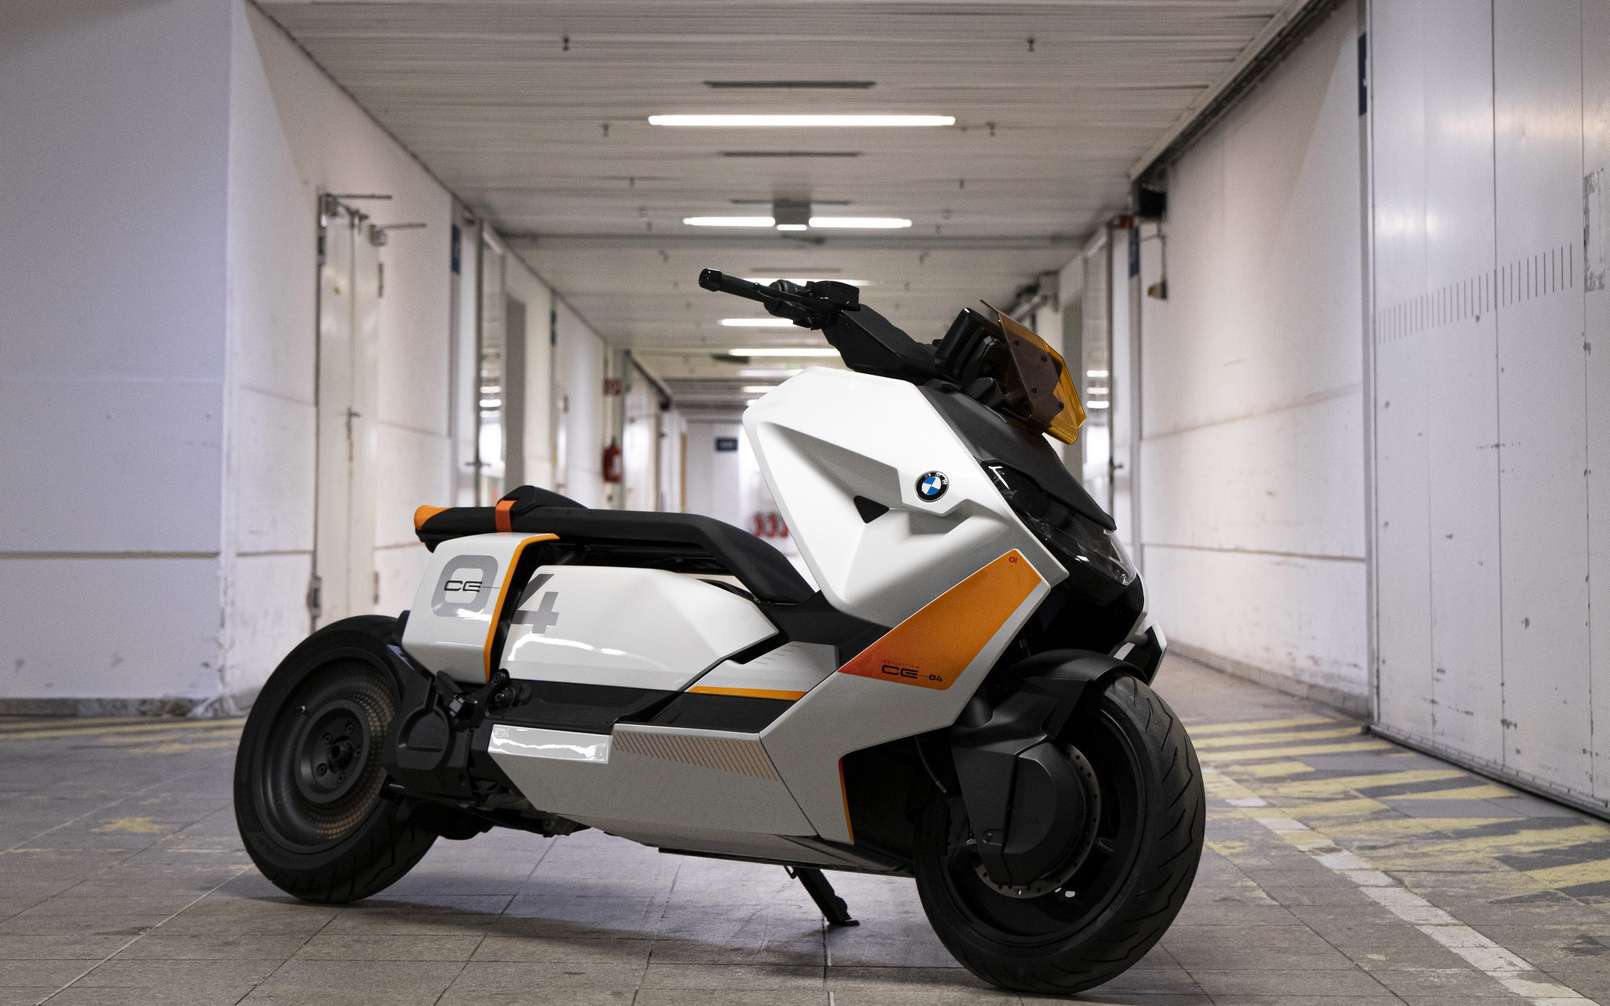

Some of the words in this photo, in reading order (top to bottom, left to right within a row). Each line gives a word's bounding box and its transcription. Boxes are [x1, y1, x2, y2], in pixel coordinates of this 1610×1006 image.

[444, 580, 483, 592] CE
[881, 665, 919, 679] CE
[928, 674, 944, 682] 04
